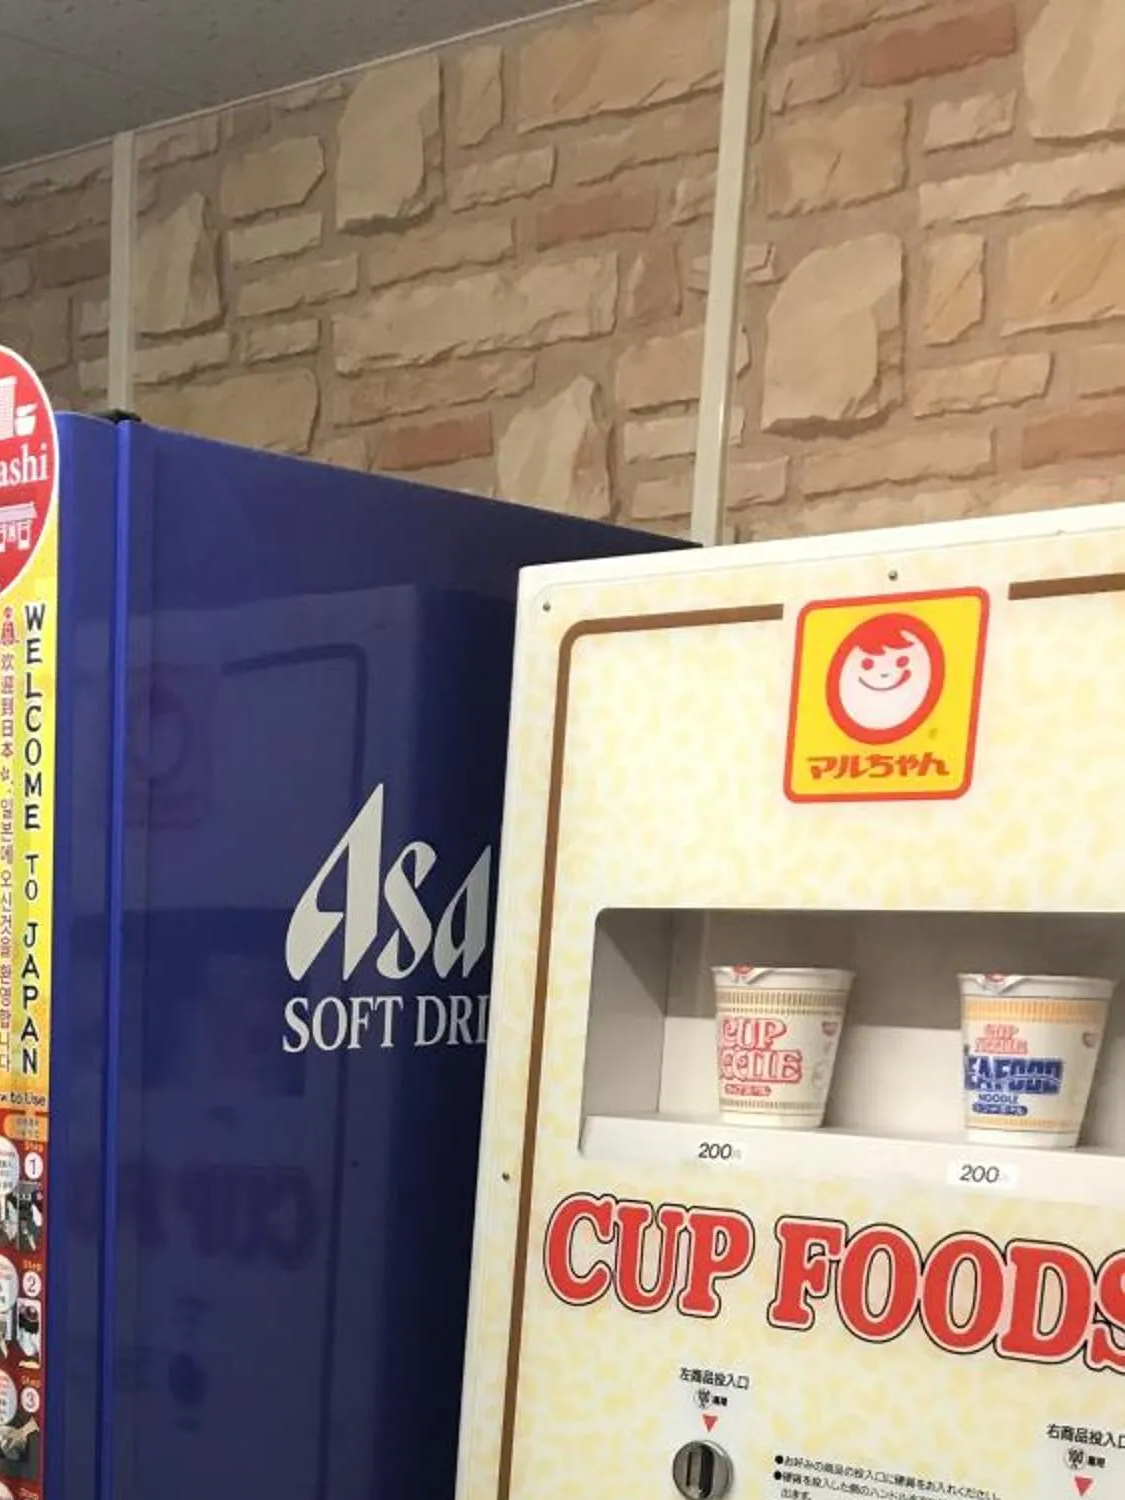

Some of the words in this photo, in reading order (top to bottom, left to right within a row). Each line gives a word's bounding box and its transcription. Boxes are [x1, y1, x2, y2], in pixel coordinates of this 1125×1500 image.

[24, 603, 46, 830] WELCOME
[806, 752, 950, 780] マルちゃん
[23, 854, 40, 901] TO
[286, 782, 492, 981] Asa
[21, 922, 40, 1075] JAPAN
[283, 995, 403, 1053] SOFT
[414, 994, 491, 1047] DRI
[697, 1143, 732, 1161] 200
[960, 1164, 1000, 1184] 200
[543, 1190, 756, 1319] CUP
[1047, 1423, 1125, 1449] 右商品投入口
